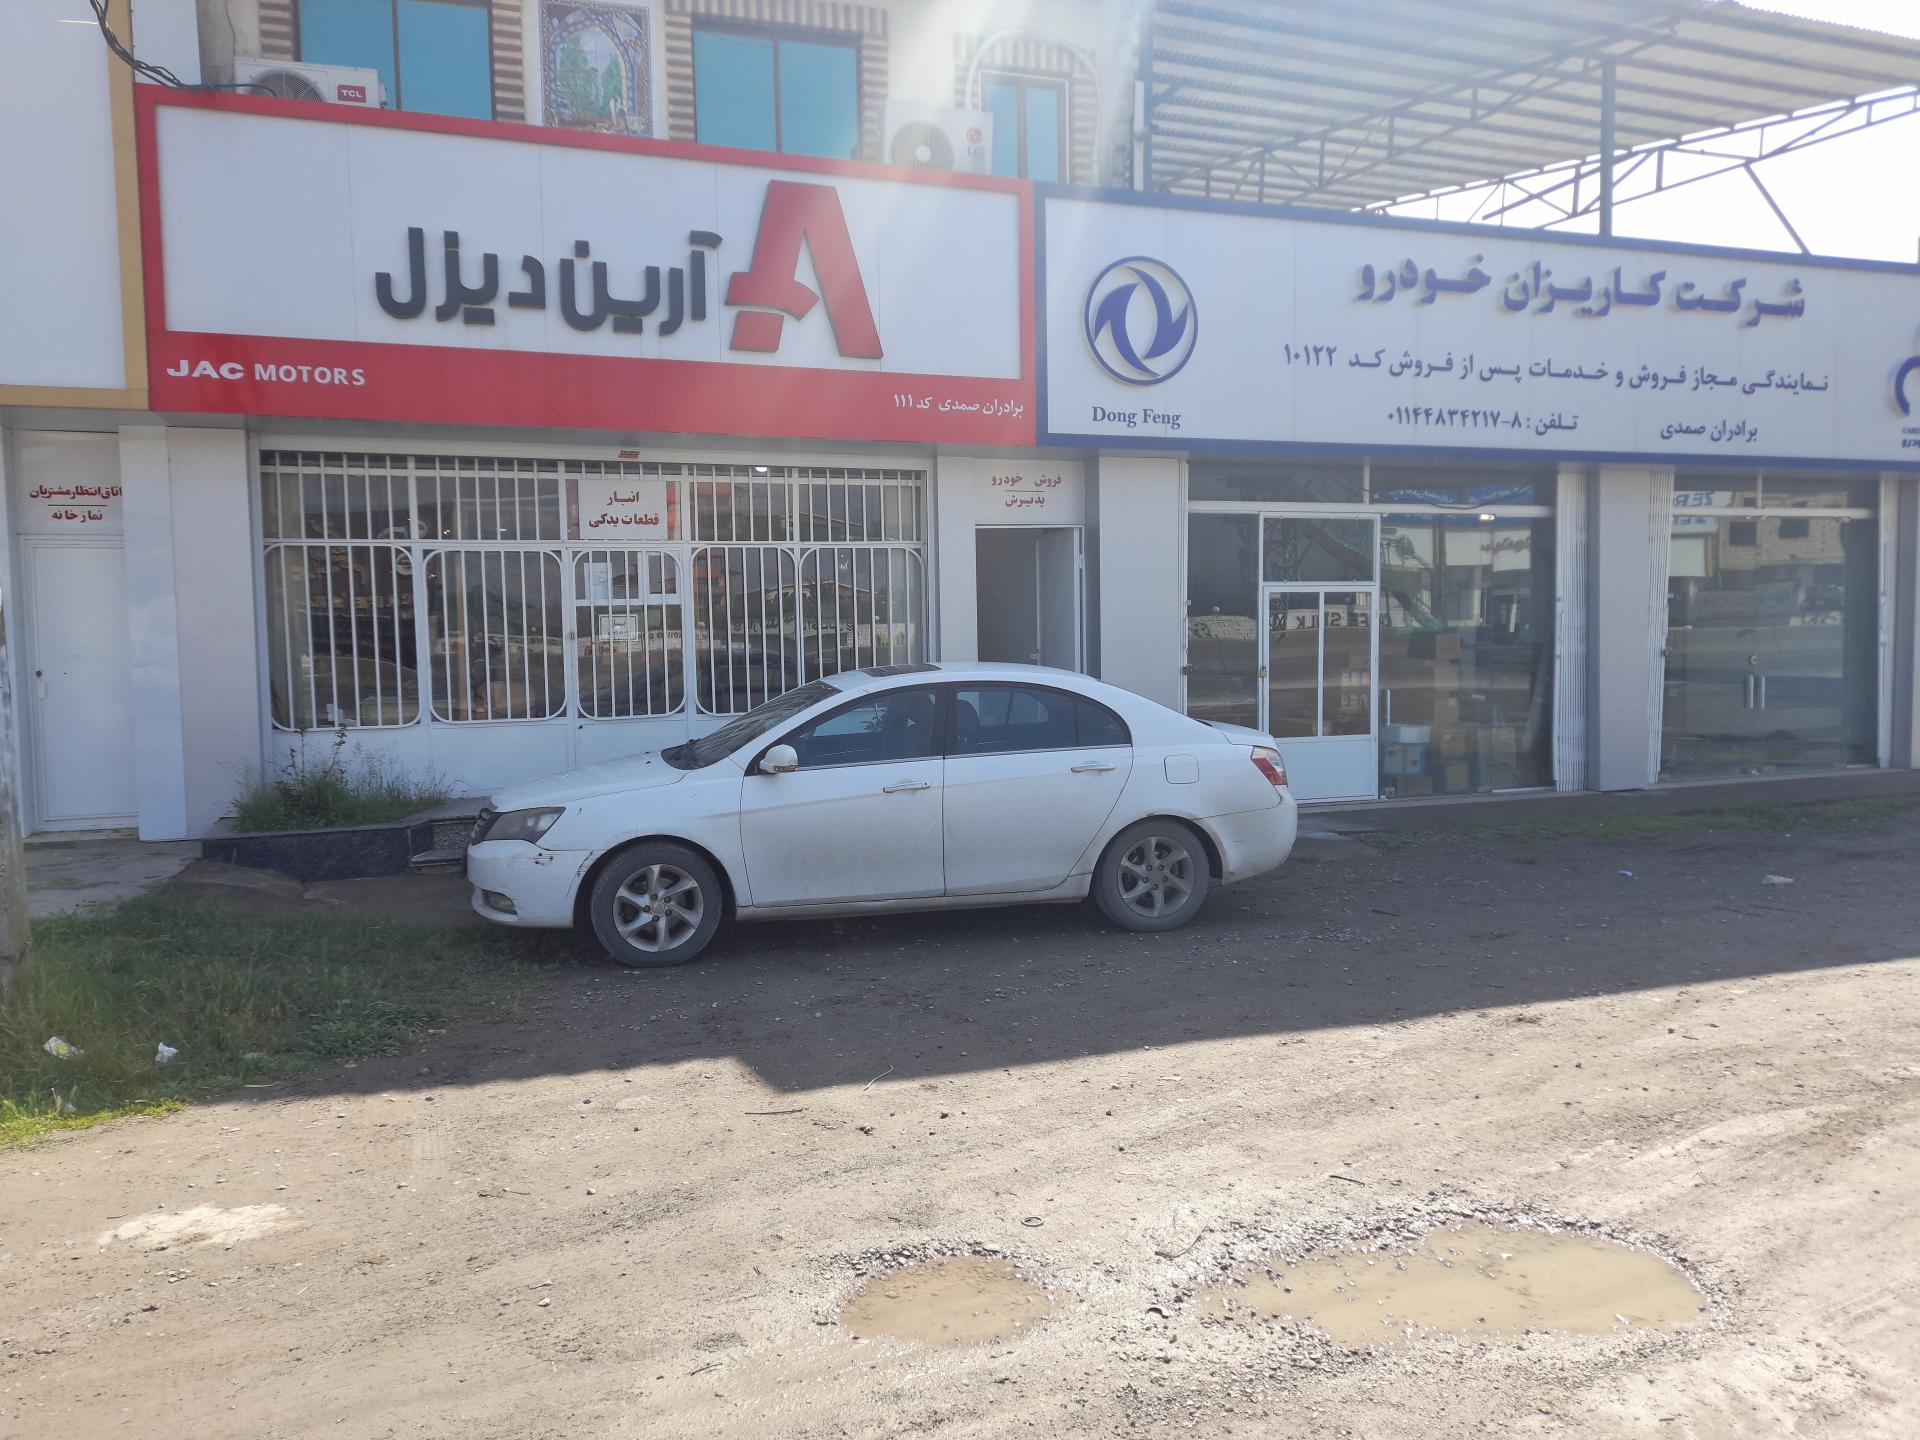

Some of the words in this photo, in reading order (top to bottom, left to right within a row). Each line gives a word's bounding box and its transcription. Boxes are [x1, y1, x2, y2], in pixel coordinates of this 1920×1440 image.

[341, 89, 363, 98] TCL
[375, 226, 546, 327] دیزل
[559, 229, 723, 336] آرین
[1357, 253, 1492, 305] خودرو
[1502, 259, 1667, 317] کاریزان
[1676, 277, 1805, 328] شرکت
[1284, 343, 1338, 368] ۱۰۱۲۲
[1348, 348, 1386, 368] کد
[1388, 350, 1454, 378] فروش
[166, 359, 245, 381] JAC
[254, 363, 367, 387] MOTORS
[1458, 353, 1474, 380] از
[1479, 364, 1521, 384] پس
[1528, 358, 1609, 380] خدمات
[1629, 364, 1687, 390] فروش
[1615, 370, 1624, 388] و
[1691, 366, 1738, 391] مجاز
[1741, 369, 1829, 396] نمایندگی
[893, 393, 914, 408] ۱۱۱
[916, 396, 933, 409] کد
[938, 399, 980, 412] صمدی
[982, 398, 1025, 419] برادران
[1091, 405, 1138, 428] Dong
[1142, 408, 1182, 430] Feng
[1659, 421, 1706, 440] صمدی
[1709, 419, 1758, 443] برادران
[991, 472, 1023, 486] خودرو
[1034, 472, 1062, 487] فروش
[606, 491, 640, 506] انبار
[1005, 494, 1045, 508] پذیرش
[588, 513, 619, 528] یدکی
[621, 513, 660, 526] قطعات
